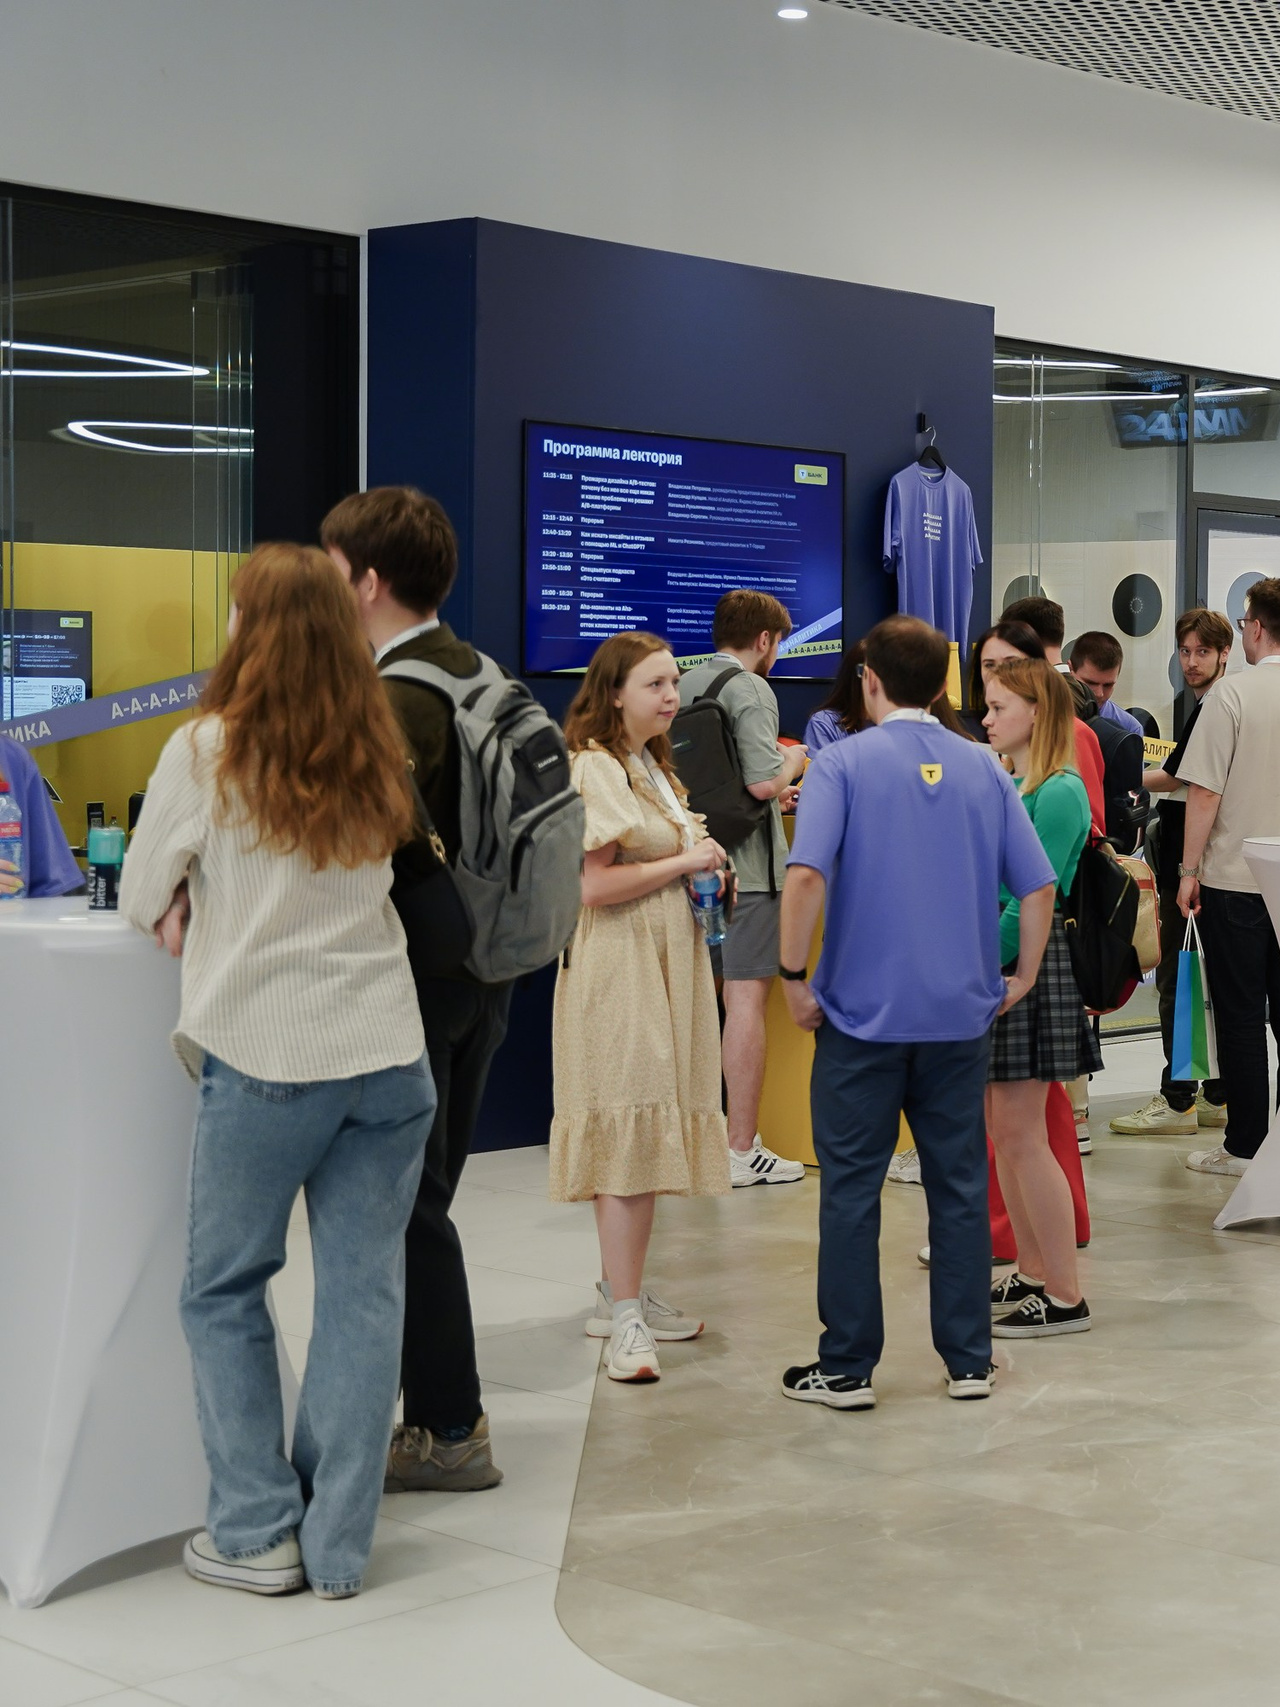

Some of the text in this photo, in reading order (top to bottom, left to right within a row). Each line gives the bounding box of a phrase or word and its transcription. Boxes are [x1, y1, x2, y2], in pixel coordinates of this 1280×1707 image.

[543, 438, 682, 467] Программа лектория
[96, 876, 106, 907] bitter
